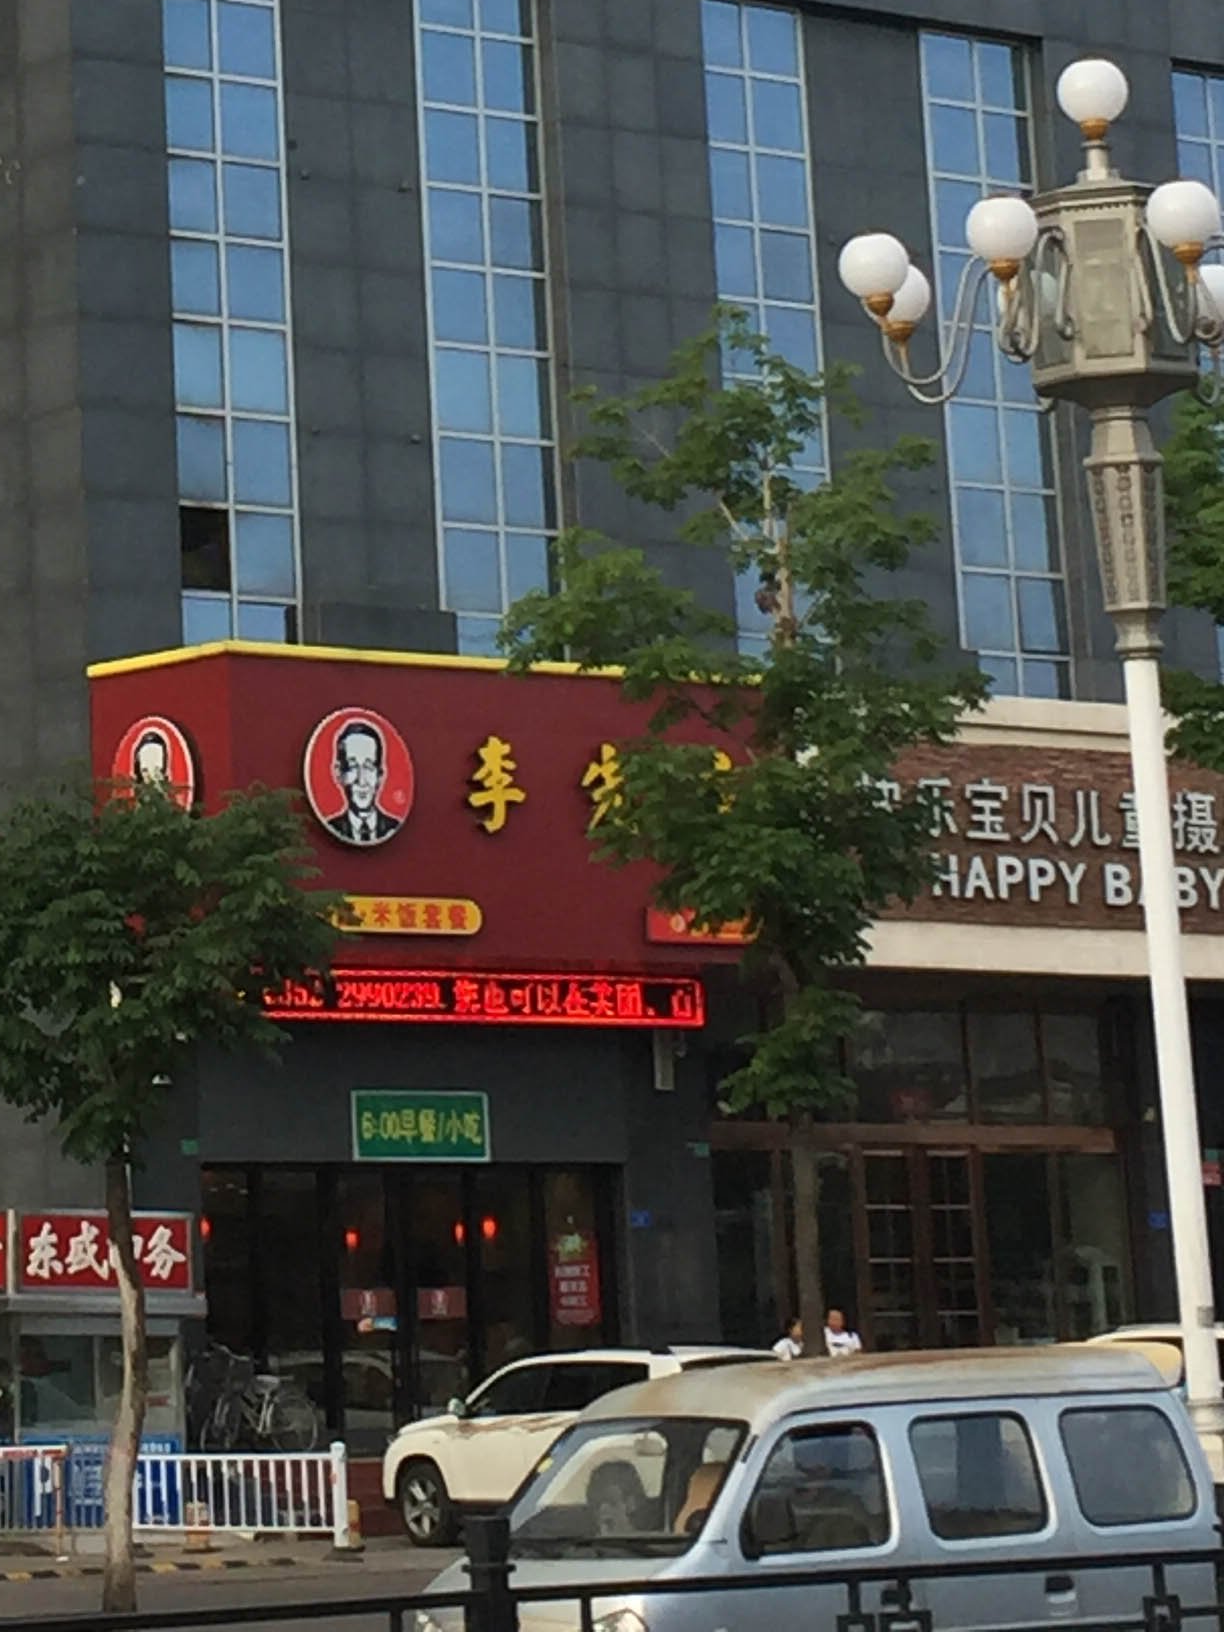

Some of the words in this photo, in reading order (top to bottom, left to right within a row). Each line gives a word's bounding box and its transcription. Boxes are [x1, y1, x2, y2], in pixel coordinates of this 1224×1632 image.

[468, 735, 736, 836] 李先
[932, 853, 1086, 906] HAPPY
[1104, 862, 1224, 911] BBY
